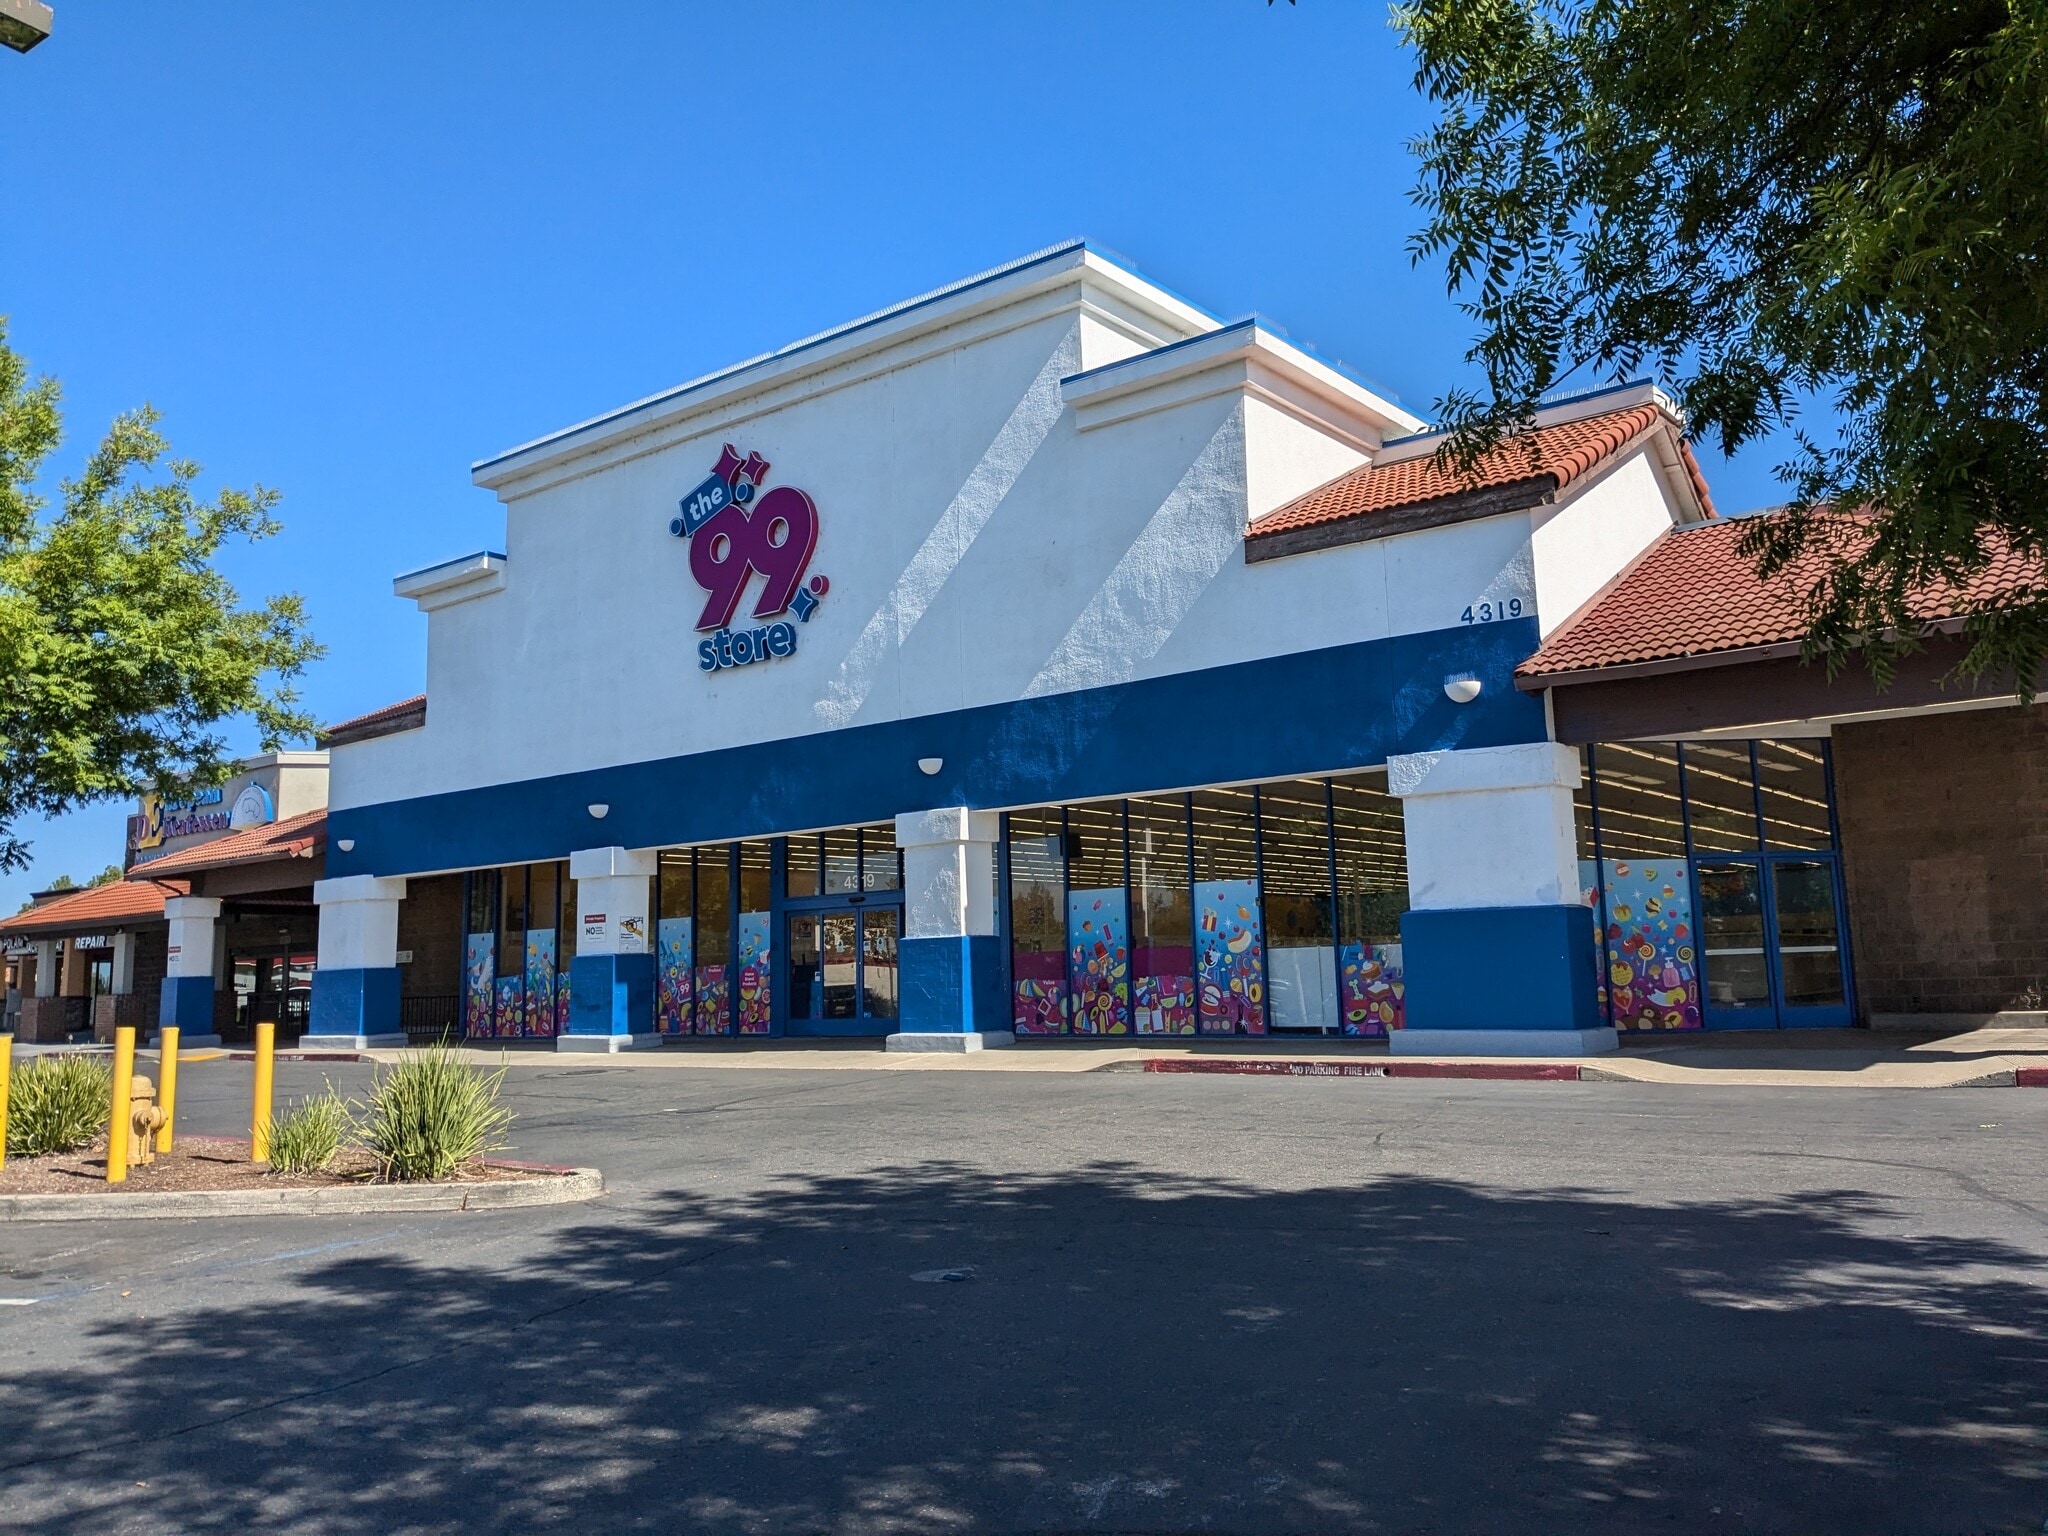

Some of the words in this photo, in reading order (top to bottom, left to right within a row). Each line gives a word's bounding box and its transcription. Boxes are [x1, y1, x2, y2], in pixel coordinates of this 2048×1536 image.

[689, 486, 723, 521] the
[688, 485, 818, 632] 99
[1460, 598, 1522, 625] 4319
[697, 622, 797, 672] store
[843, 873, 875, 889] 4319
[585, 926, 596, 935] NO
[75, 936, 105, 950] REPAIR
[680, 983, 690, 995] 99
[1291, 1065, 1303, 1074] NO
[1305, 1066, 1340, 1075] PARKING
[1344, 1066, 1362, 1076] FIRE
